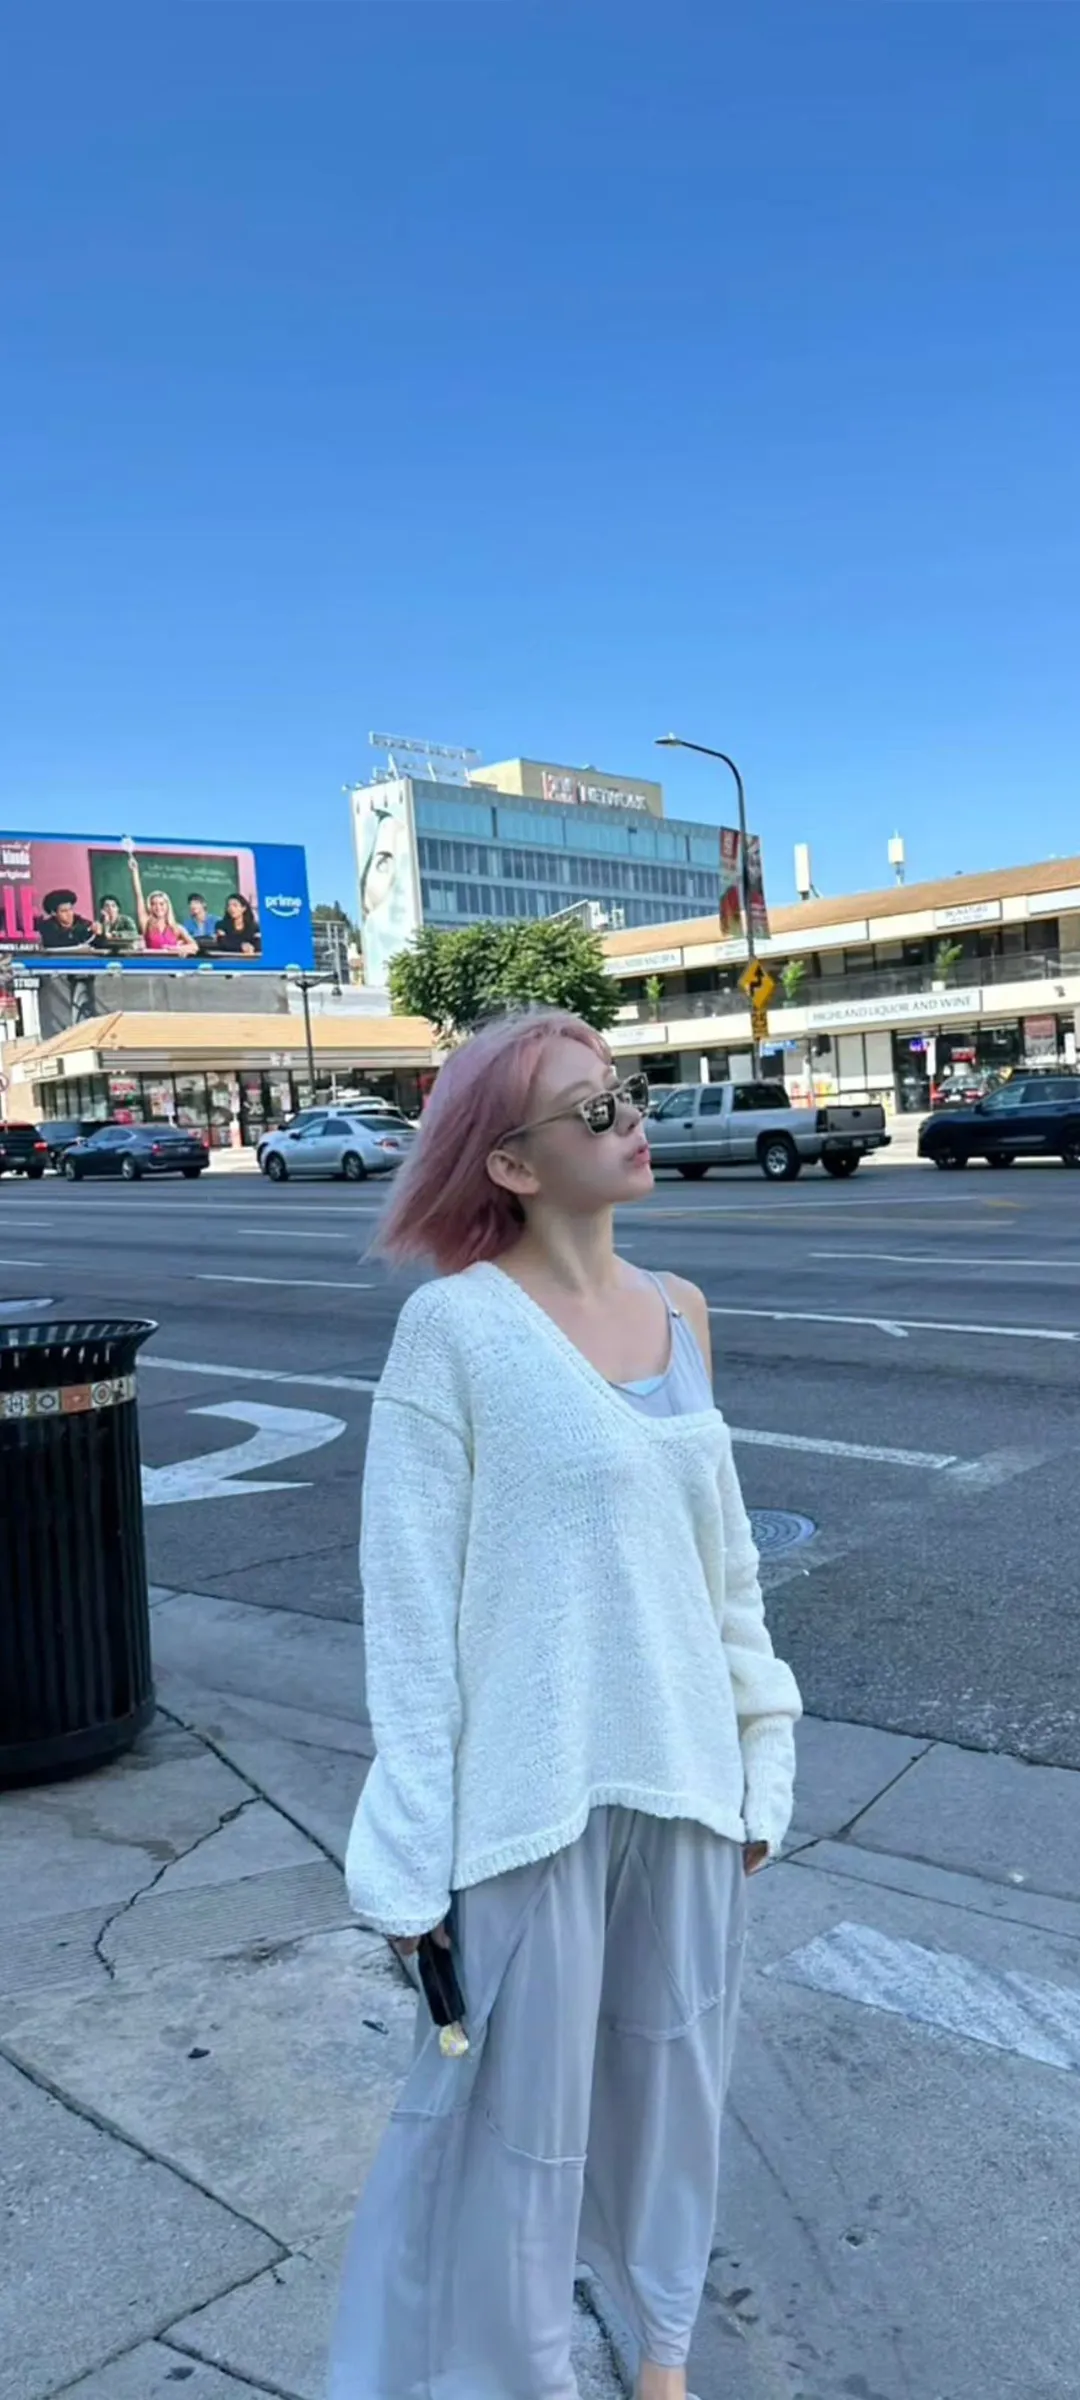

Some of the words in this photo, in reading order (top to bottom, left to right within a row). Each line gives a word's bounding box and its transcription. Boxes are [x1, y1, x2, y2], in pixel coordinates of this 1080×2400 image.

[264, 893, 302, 908] prime
[813, 1007, 867, 1021] HIGHLAND
[869, 1002, 909, 1016] LIQUOR
[912, 999, 937, 1012] AND
[940, 994, 972, 1008] WINE
